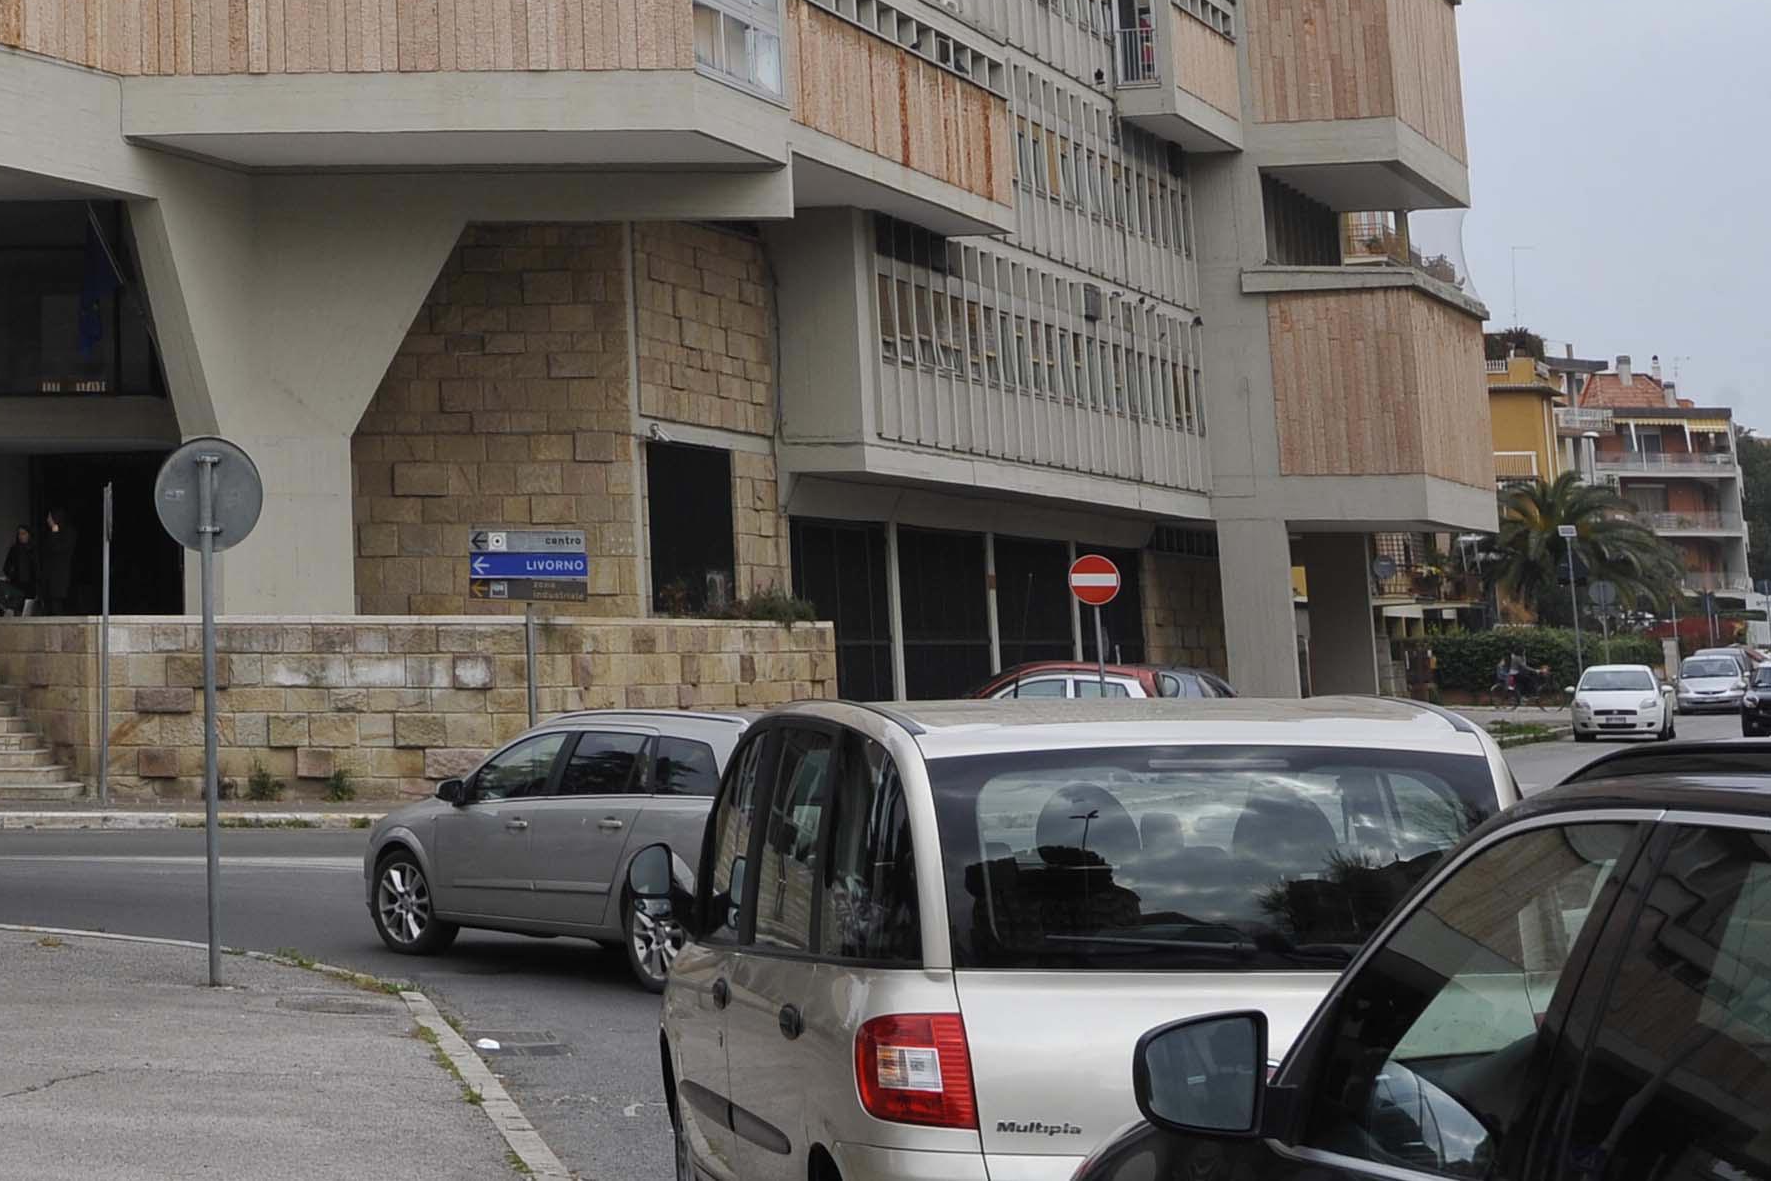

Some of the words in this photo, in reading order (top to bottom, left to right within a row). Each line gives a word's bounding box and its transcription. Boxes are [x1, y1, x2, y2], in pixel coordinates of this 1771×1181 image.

[545, 535, 582, 545] centro
[526, 559, 584, 571] LIVORNO
[996, 1121, 1083, 1137] Multipla
